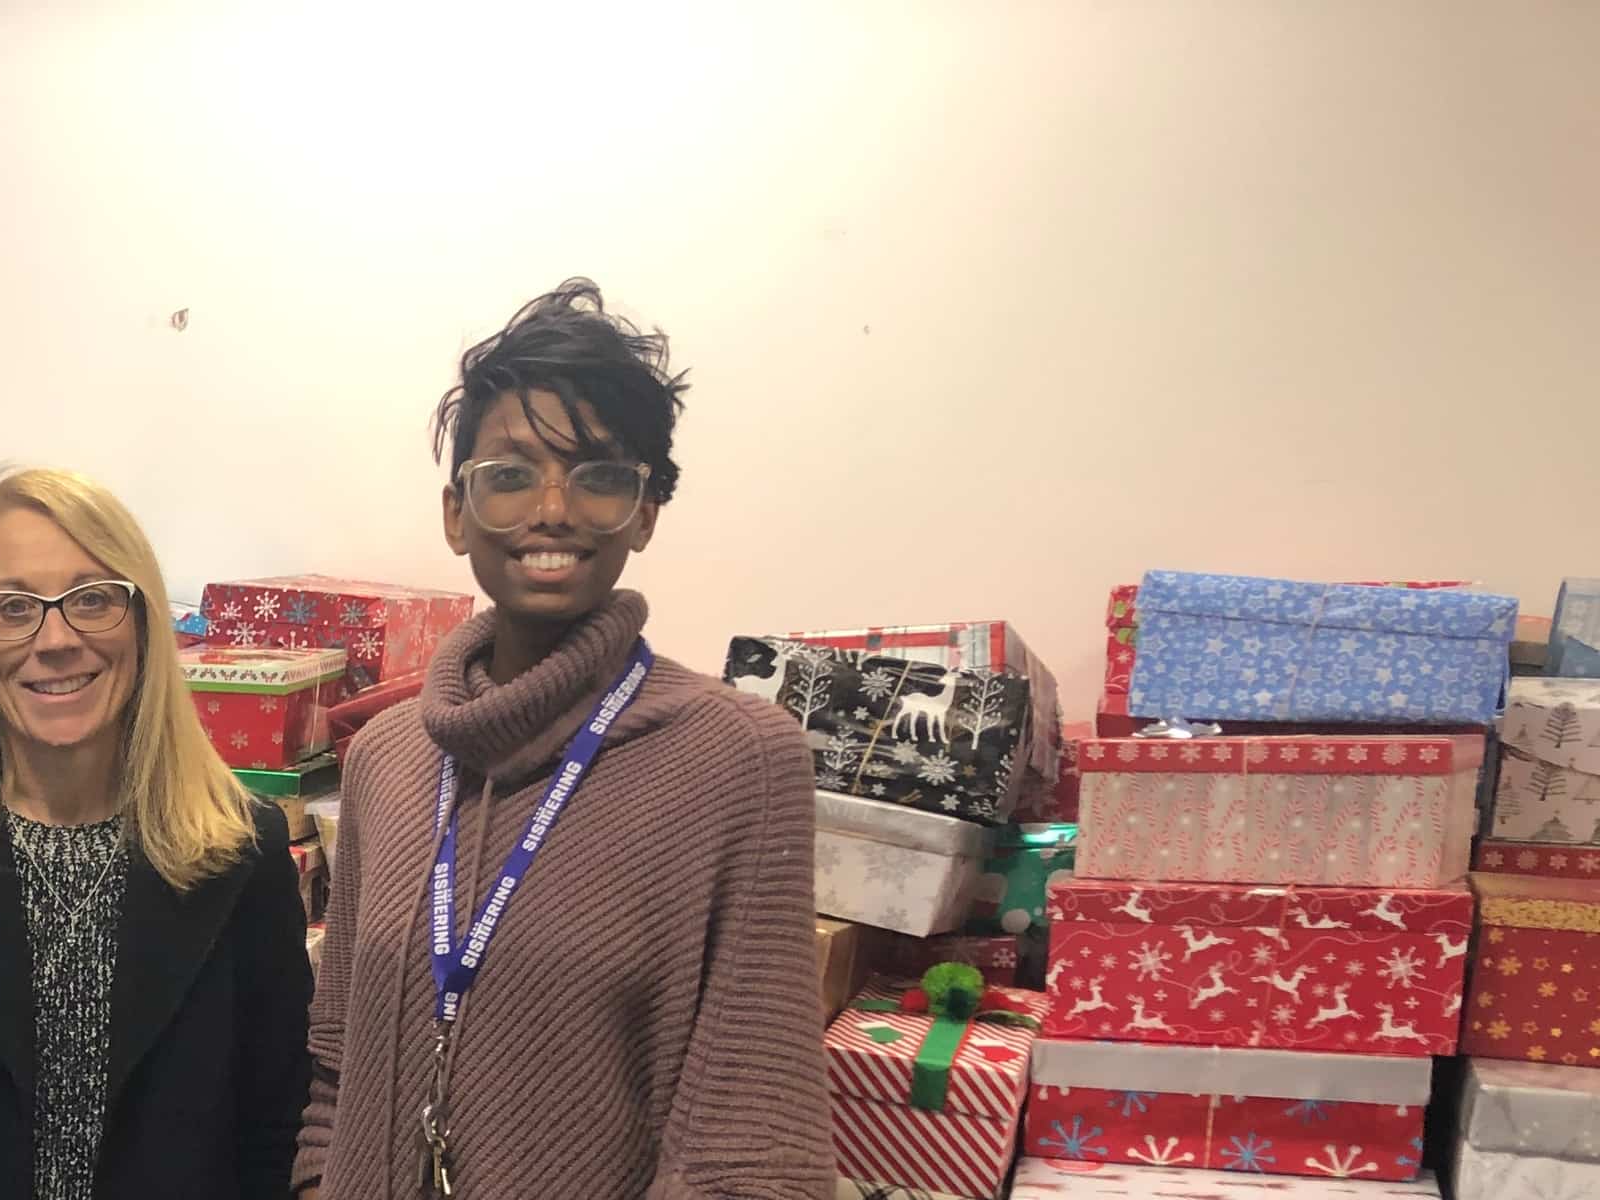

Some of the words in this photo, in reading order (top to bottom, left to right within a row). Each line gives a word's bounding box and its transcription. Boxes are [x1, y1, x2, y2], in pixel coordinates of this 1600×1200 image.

[522, 761, 583, 852] SISTERING
[434, 862, 453, 956] SISTERING
[461, 876, 517, 969] SISTERING
